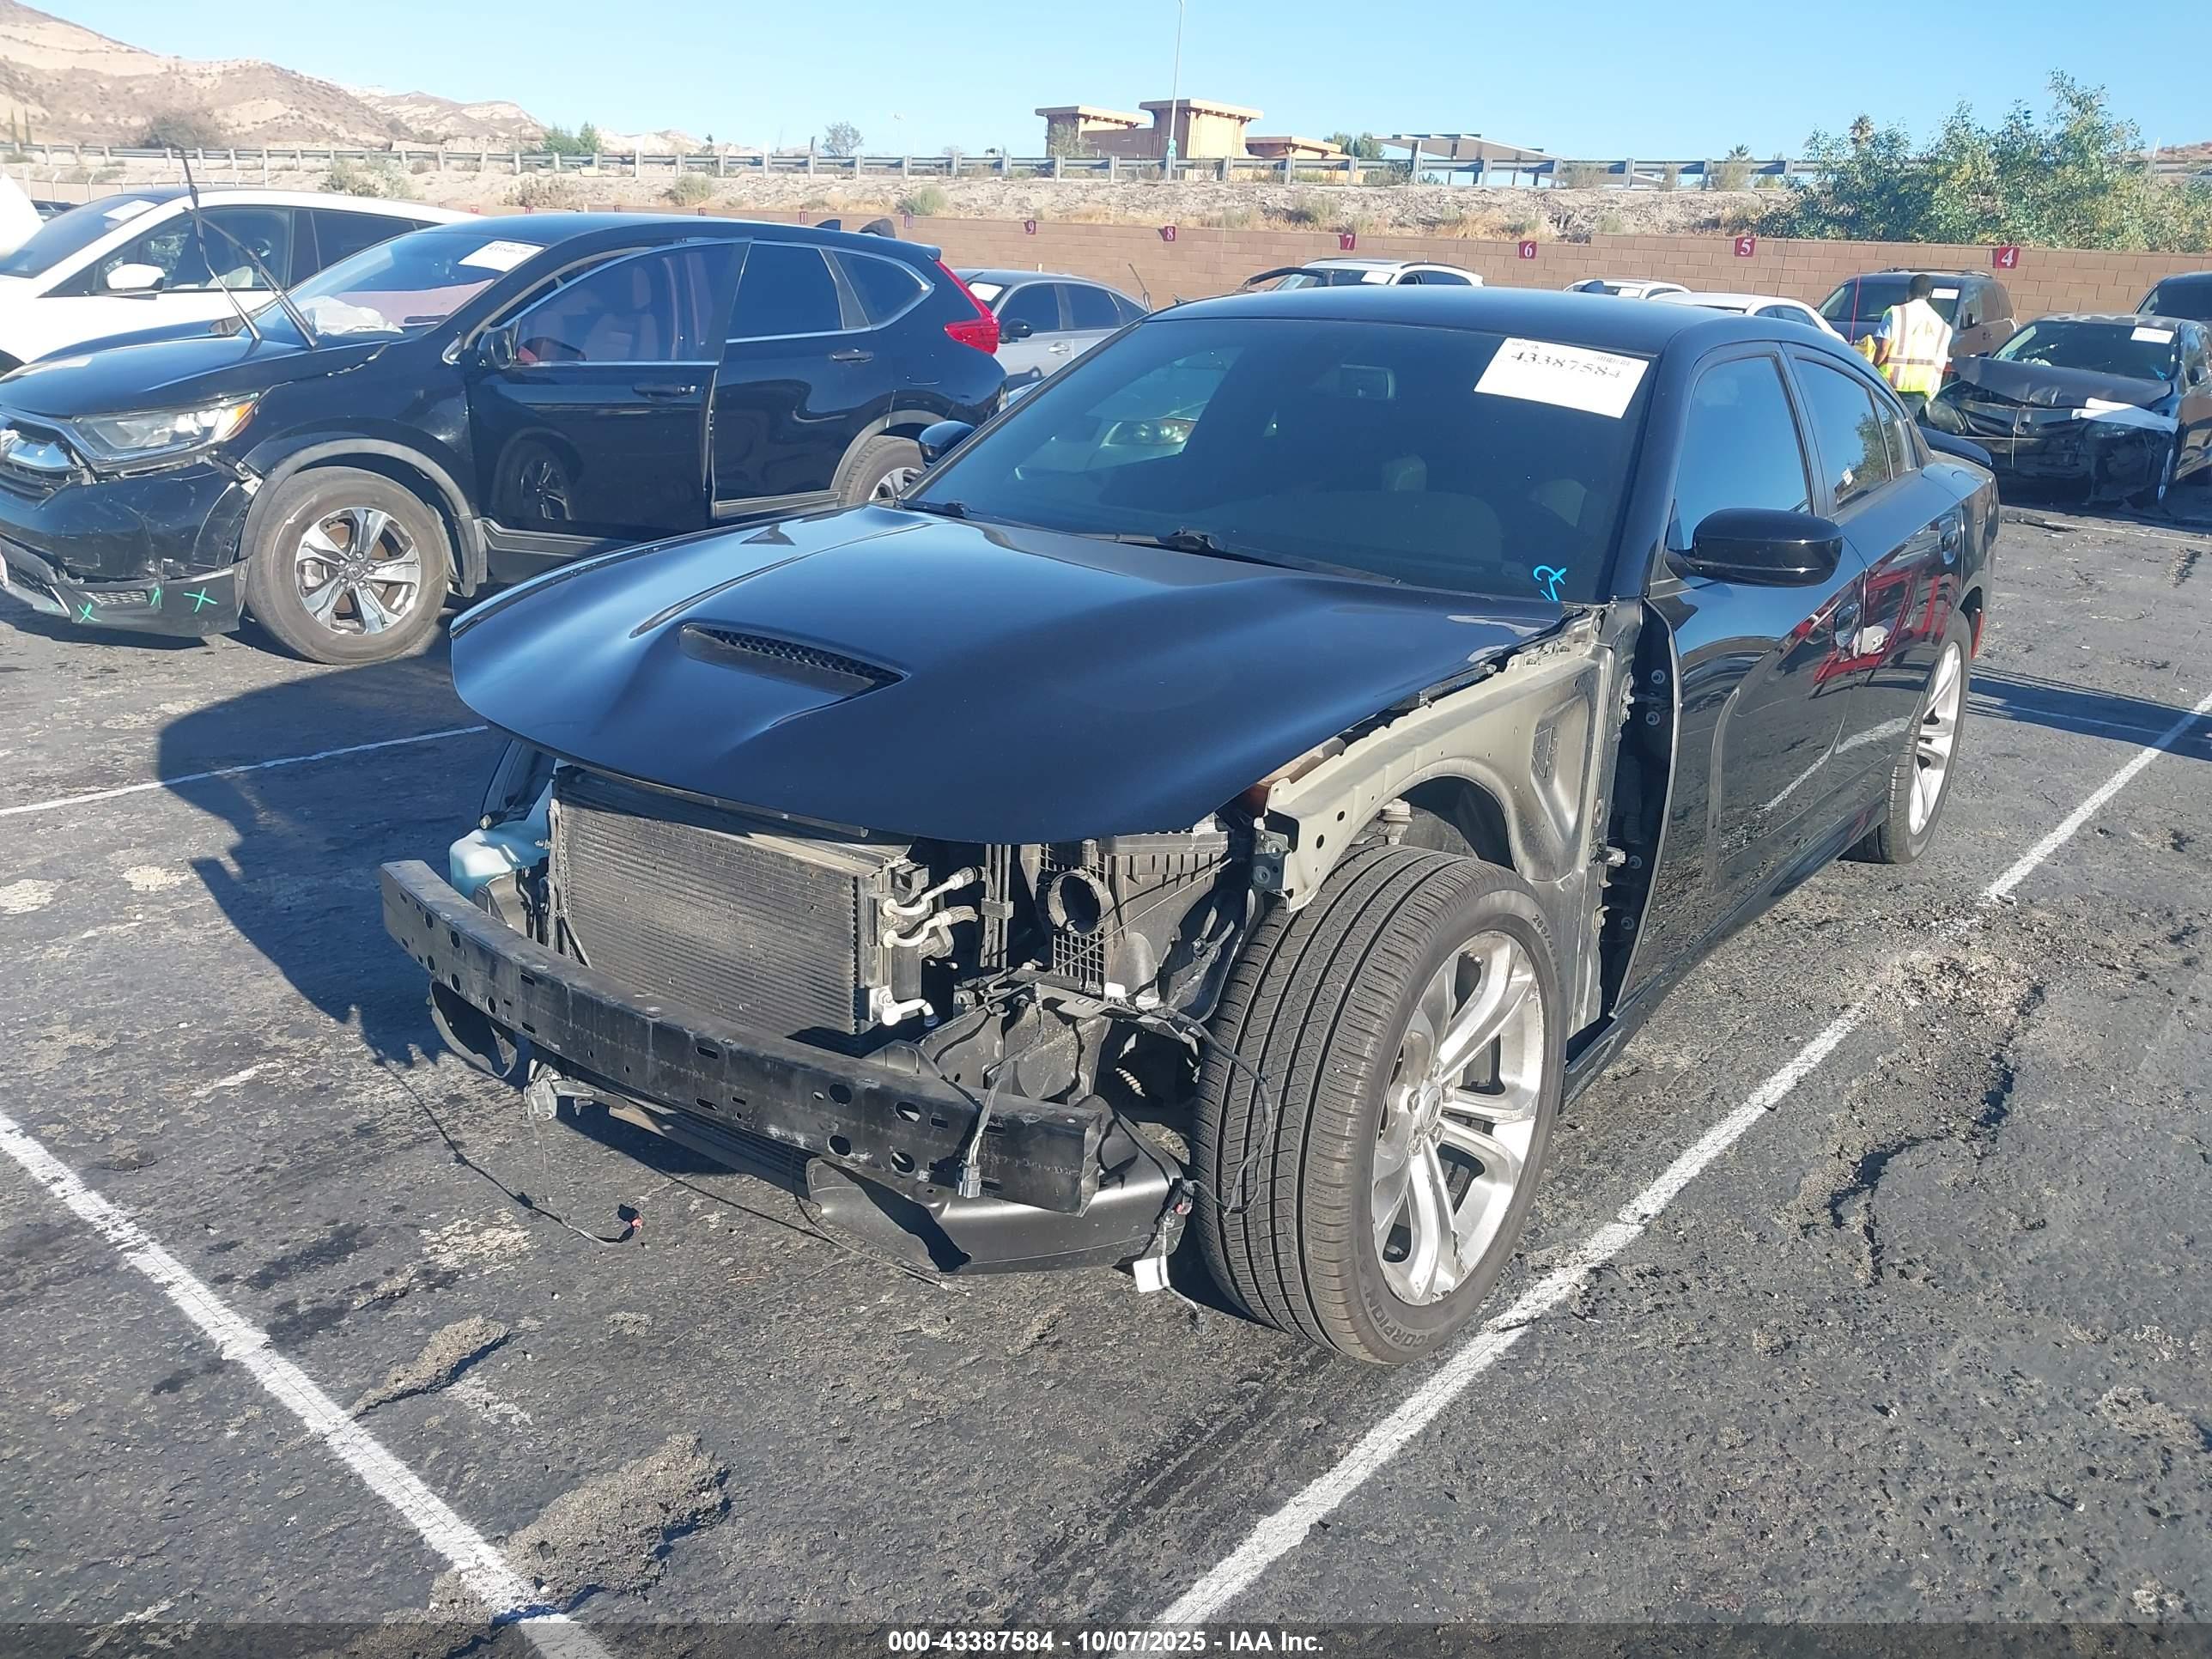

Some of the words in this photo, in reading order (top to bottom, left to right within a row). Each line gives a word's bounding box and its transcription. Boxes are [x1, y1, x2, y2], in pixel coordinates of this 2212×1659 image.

[1028, 221, 1035, 233] 9
[1167, 227, 1173, 240] 8
[1346, 234, 1352, 248] 7
[1740, 238, 1752, 255] 5
[1524, 242, 1533, 258] 6
[2001, 248, 2014, 267] 4
[1511, 351, 1621, 379] 43387584
